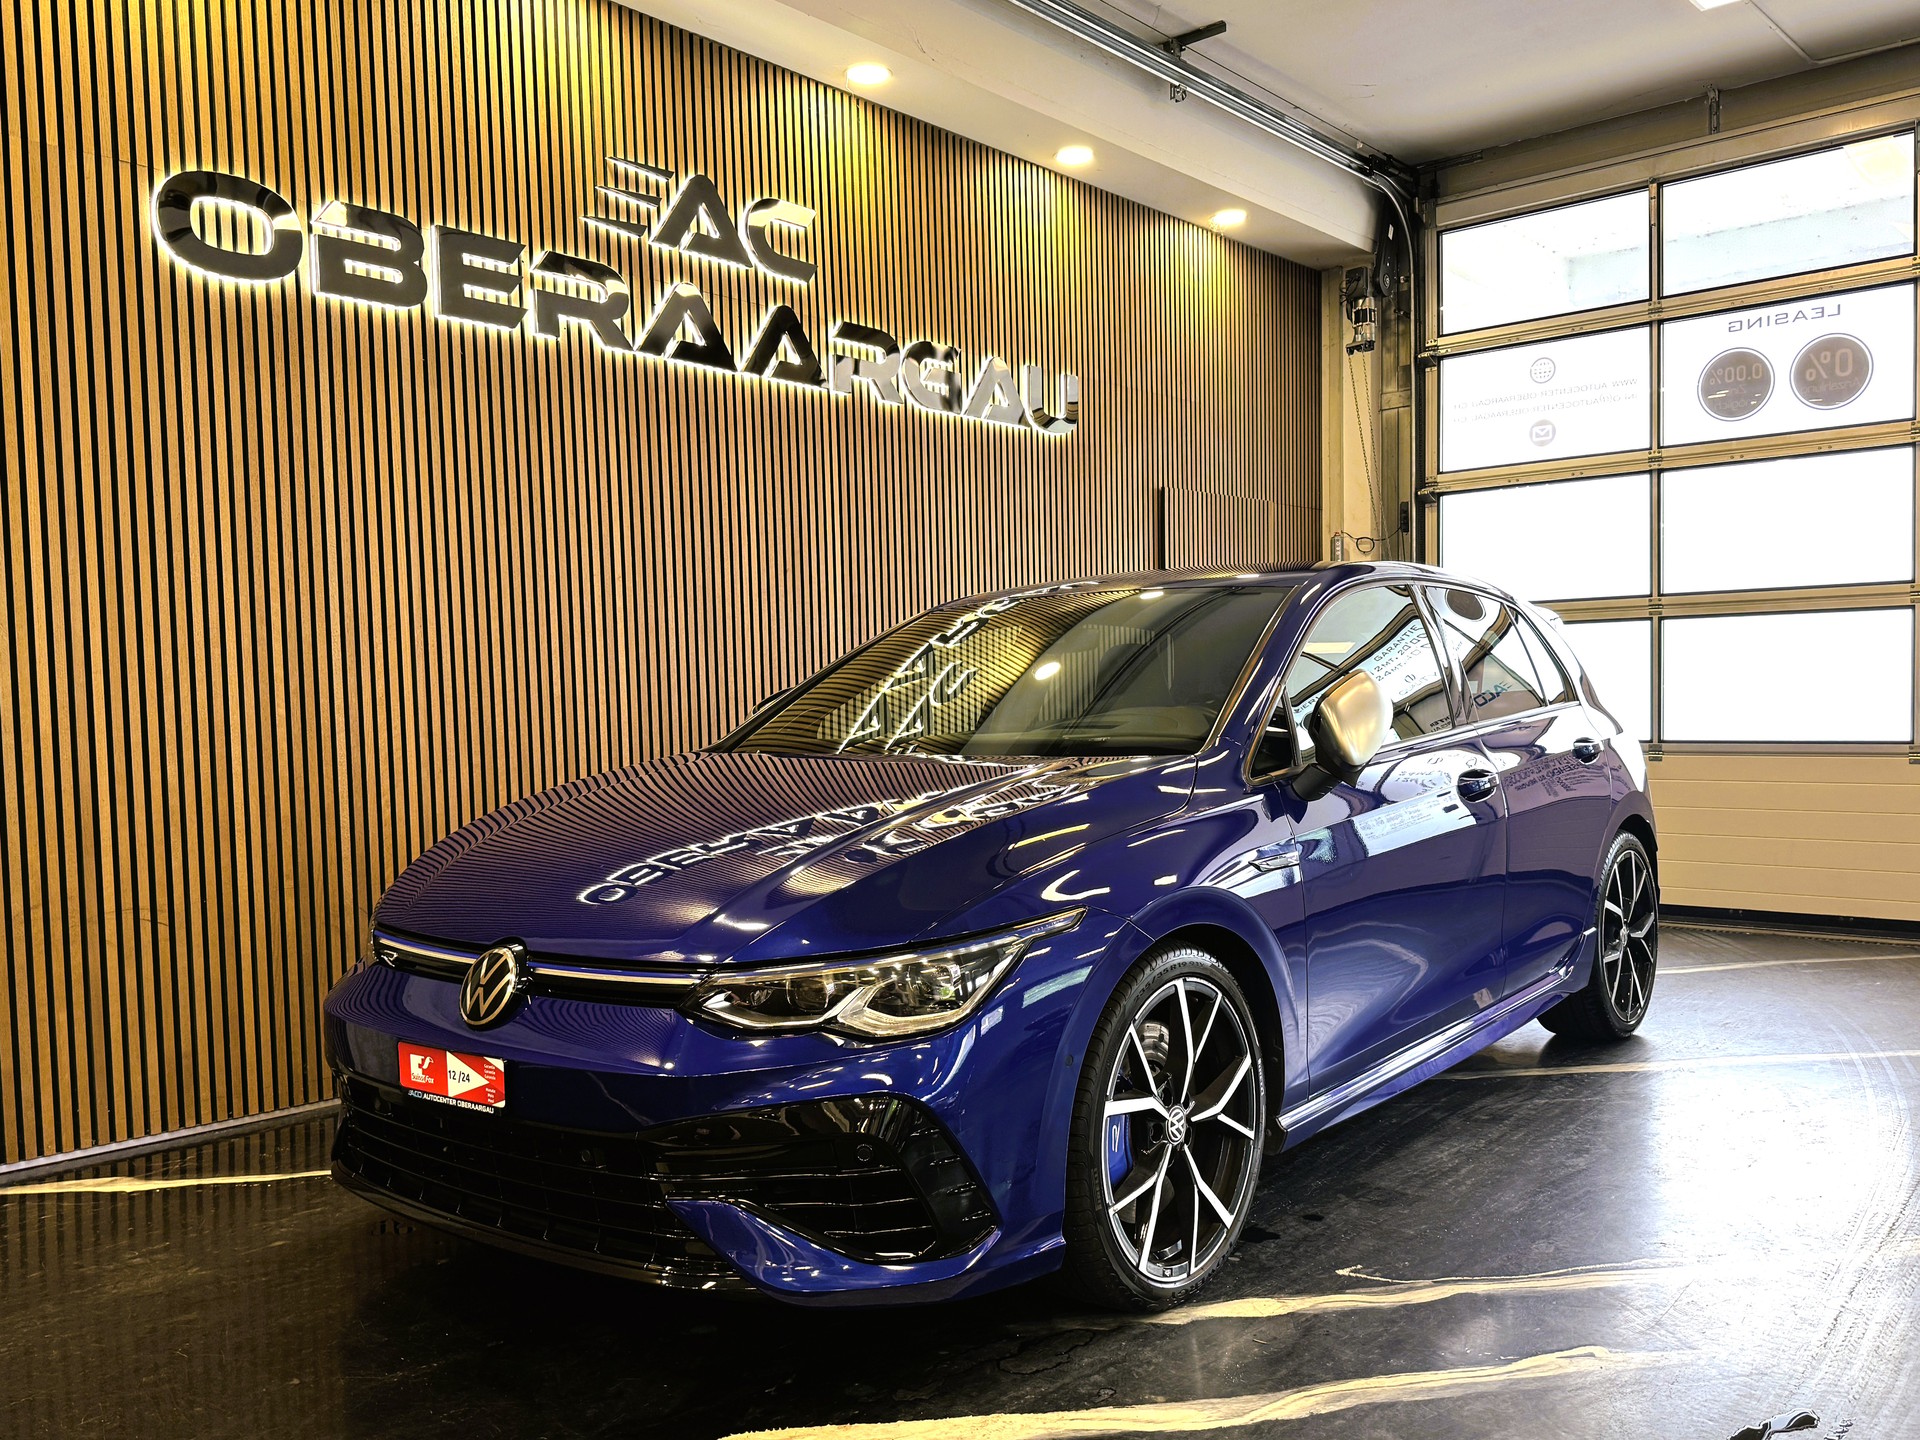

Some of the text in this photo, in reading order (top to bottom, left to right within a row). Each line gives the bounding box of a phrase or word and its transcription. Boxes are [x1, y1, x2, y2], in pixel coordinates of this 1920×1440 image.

[153, 170, 1079, 435] OBERAARGAU
[423, 1092, 457, 1106] AUTOCENTER
[457, 1100, 494, 1114] OBERAARGAU
